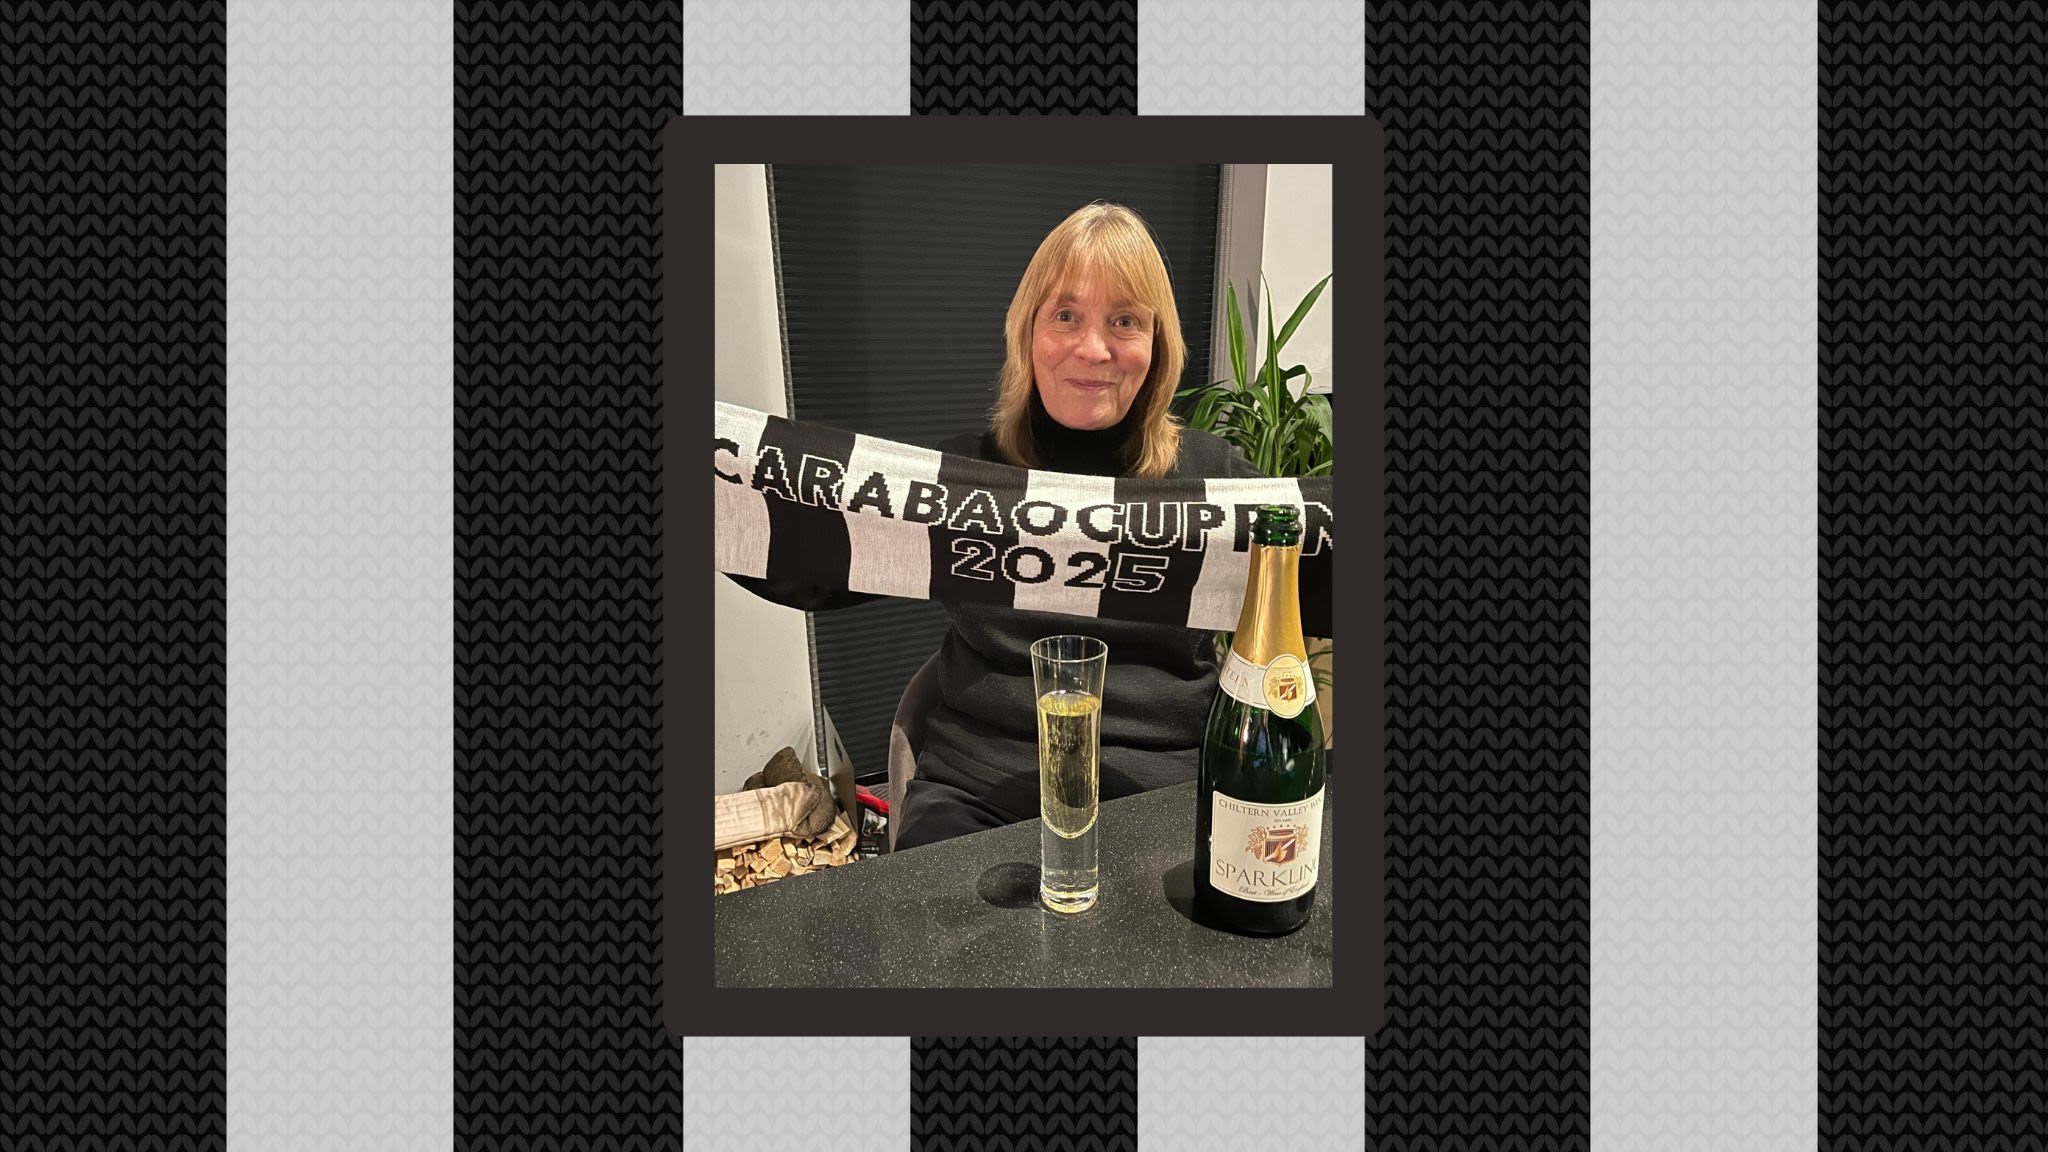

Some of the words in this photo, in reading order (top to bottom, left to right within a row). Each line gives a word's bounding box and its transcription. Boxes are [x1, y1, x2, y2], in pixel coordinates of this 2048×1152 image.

[951, 538, 1169, 593] 2025
[1218, 799, 1269, 817] CHILTERN
[1273, 804, 1308, 817] VALLEY
